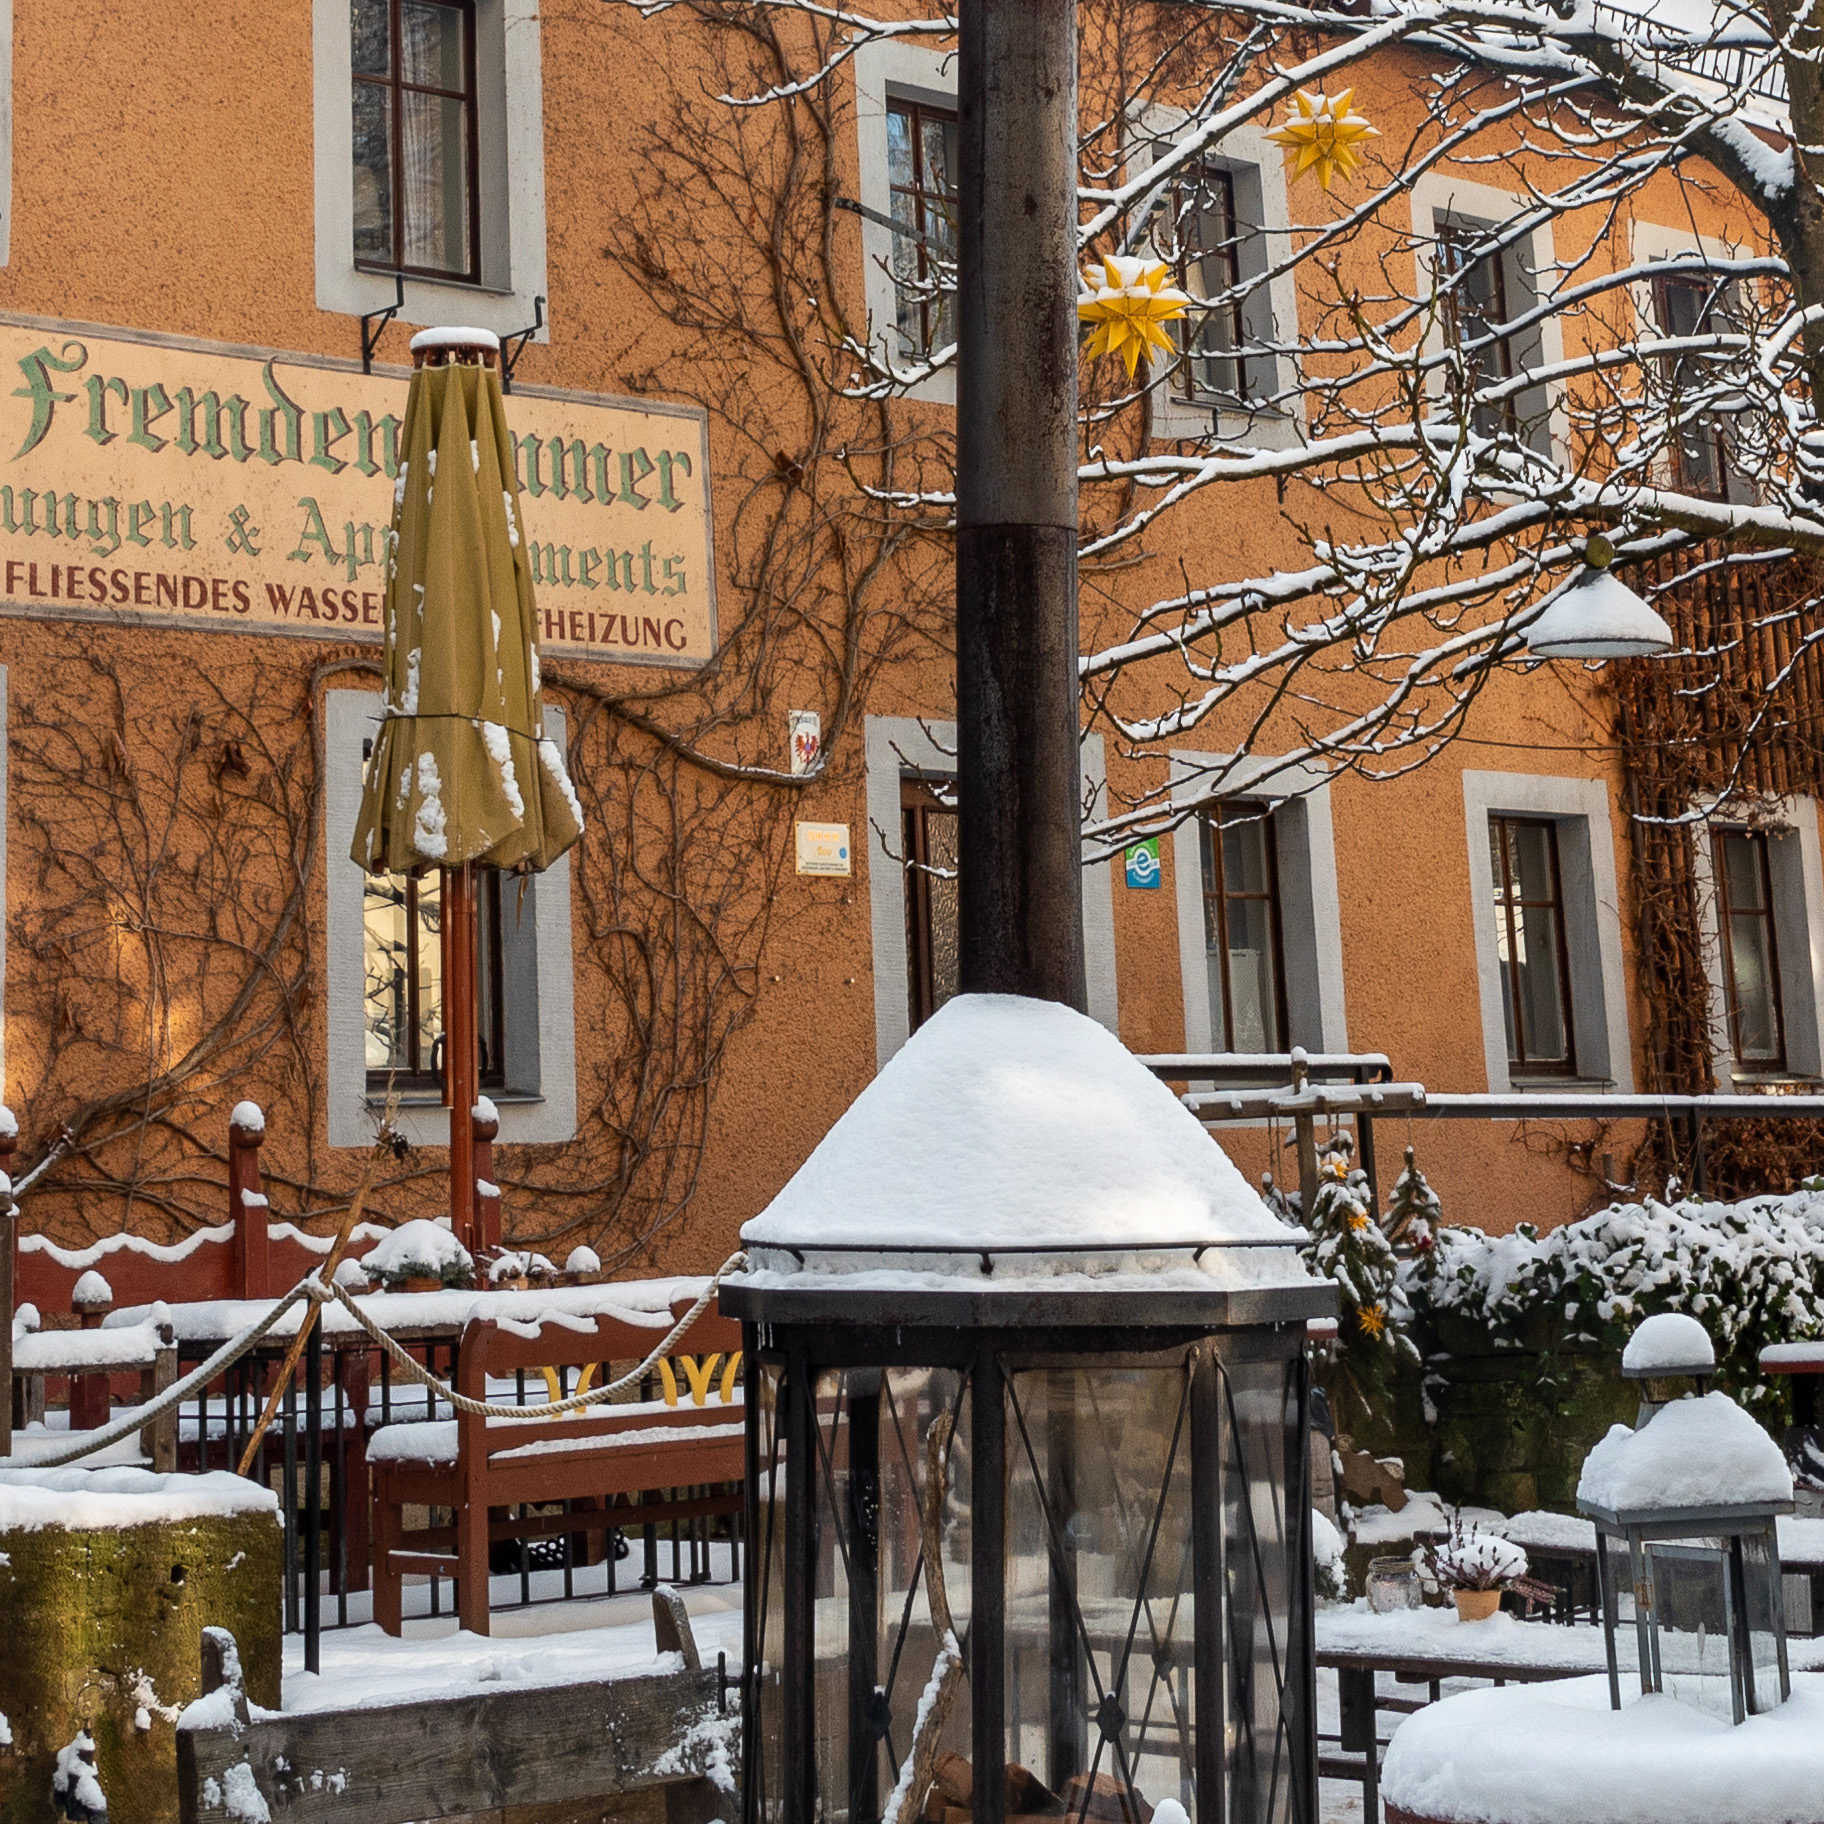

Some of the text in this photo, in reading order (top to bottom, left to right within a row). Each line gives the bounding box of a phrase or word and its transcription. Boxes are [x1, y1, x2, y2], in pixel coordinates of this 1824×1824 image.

[224, 503, 263, 556] &
[5, 559, 252, 614] FLIESSENDES
[536, 607, 688, 651] HEIZUNG
